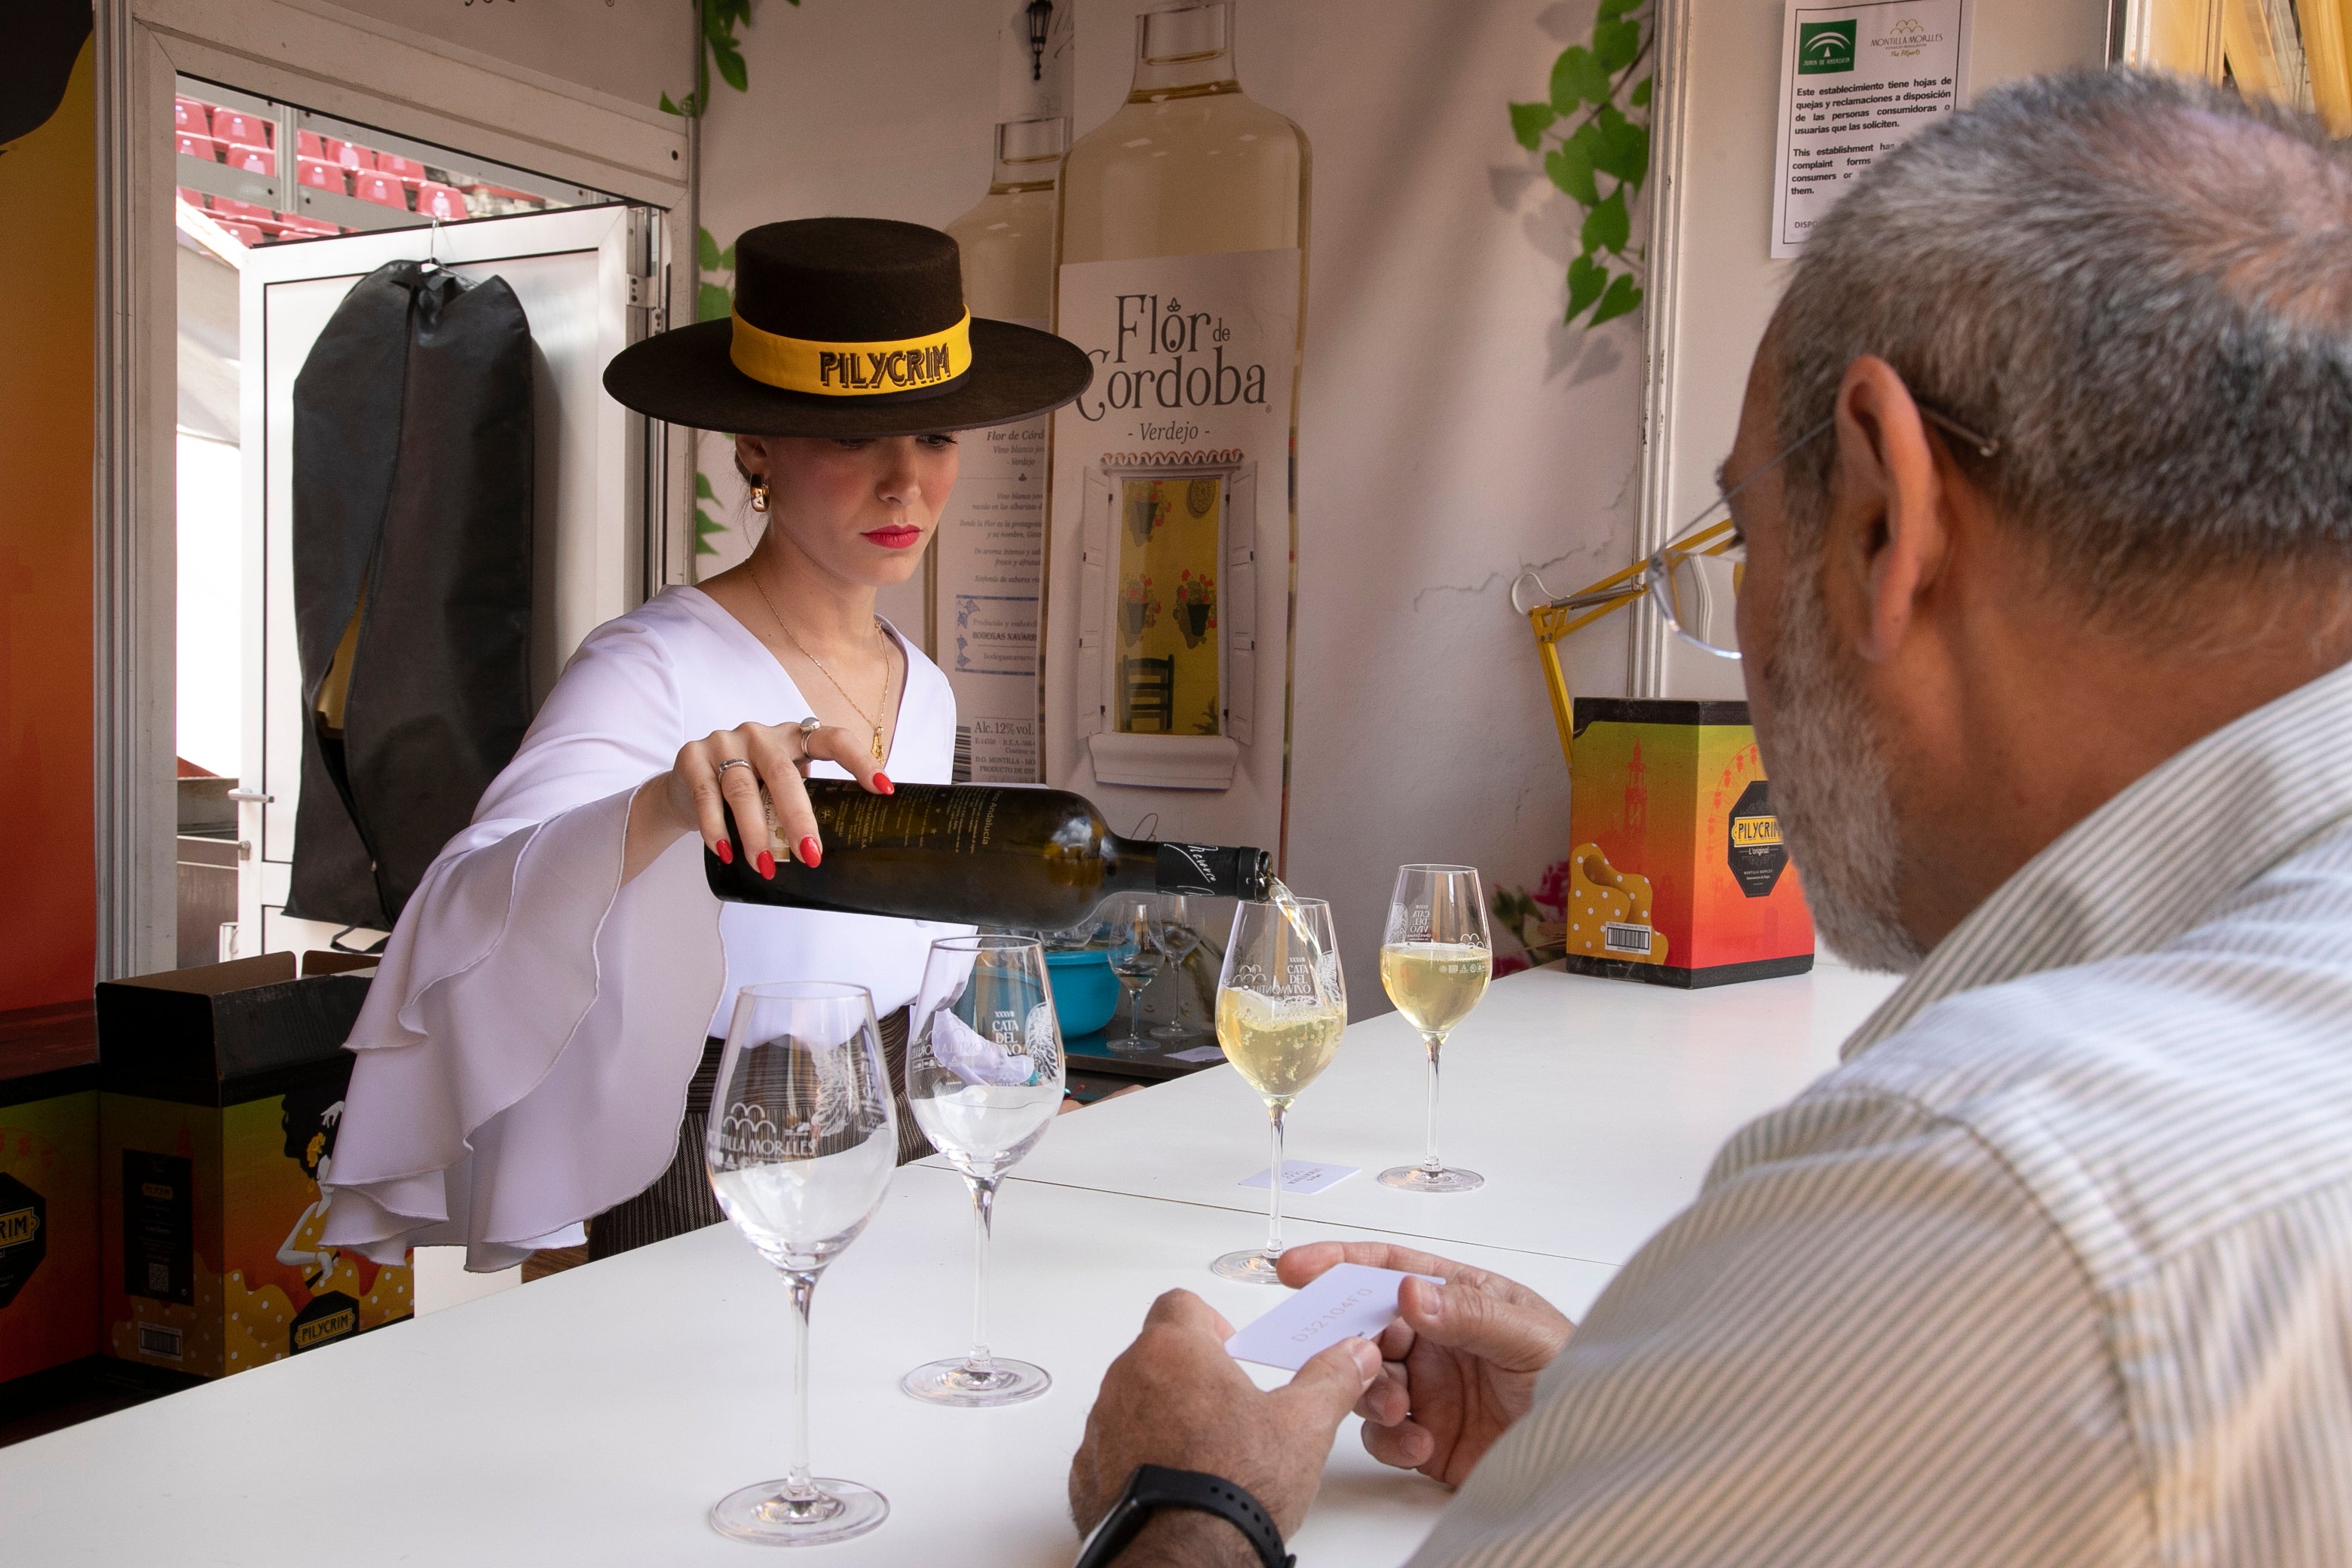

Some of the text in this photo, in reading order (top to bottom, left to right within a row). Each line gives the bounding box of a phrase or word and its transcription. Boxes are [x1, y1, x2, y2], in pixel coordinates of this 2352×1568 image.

[1796, 76, 1952, 96] Este establecimiento tiene hojas de
[1796, 100, 1824, 111] quejas
[1825, 101, 1830, 109] y
[1833, 95, 1893, 107] reclamaciones
[1903, 90, 1951, 102] disposición
[1795, 114, 1806, 122] de
[1813, 113, 1825, 121] las
[1832, 110, 1870, 121] personas
[1877, 104, 1937, 115] consumidoras
[1795, 119, 1900, 135] usuarias que las soliciten.
[1793, 149, 1811, 157] This
[1816, 144, 1874, 156] establishment
[1793, 158, 1871, 170] complaint forms
[1791, 173, 1837, 182] consumers
[1790, 187, 1815, 195] them.
[1113, 294, 1231, 363] Flor de
[819, 342, 951, 389] PILYCRIM
[986, 430, 1006, 441] Flor
[1008, 429, 1020, 440] de
[1139, 422, 1199, 443] Verdejo
[993, 446, 1009, 454] Vino
[1011, 444, 1034, 454] blanco
[972, 631, 1006, 641] BODEGAS
[974, 721, 1035, 736] Alc. 12% vol.
[979, 765, 1013, 773] PRODUCTO
[982, 802, 997, 845] Andalucía
[1749, 847, 1769, 856] L'original
[1287, 964, 1309, 975] CATA
[1289, 974, 1308, 985] DEL
[1288, 984, 1311, 994] VINO
[992, 1020, 1019, 1032] CATA
[995, 1032, 1018, 1044] DEL
[749, 1137, 816, 1157] MORILES
[302, 1314, 348, 1343] PILYCRIM
